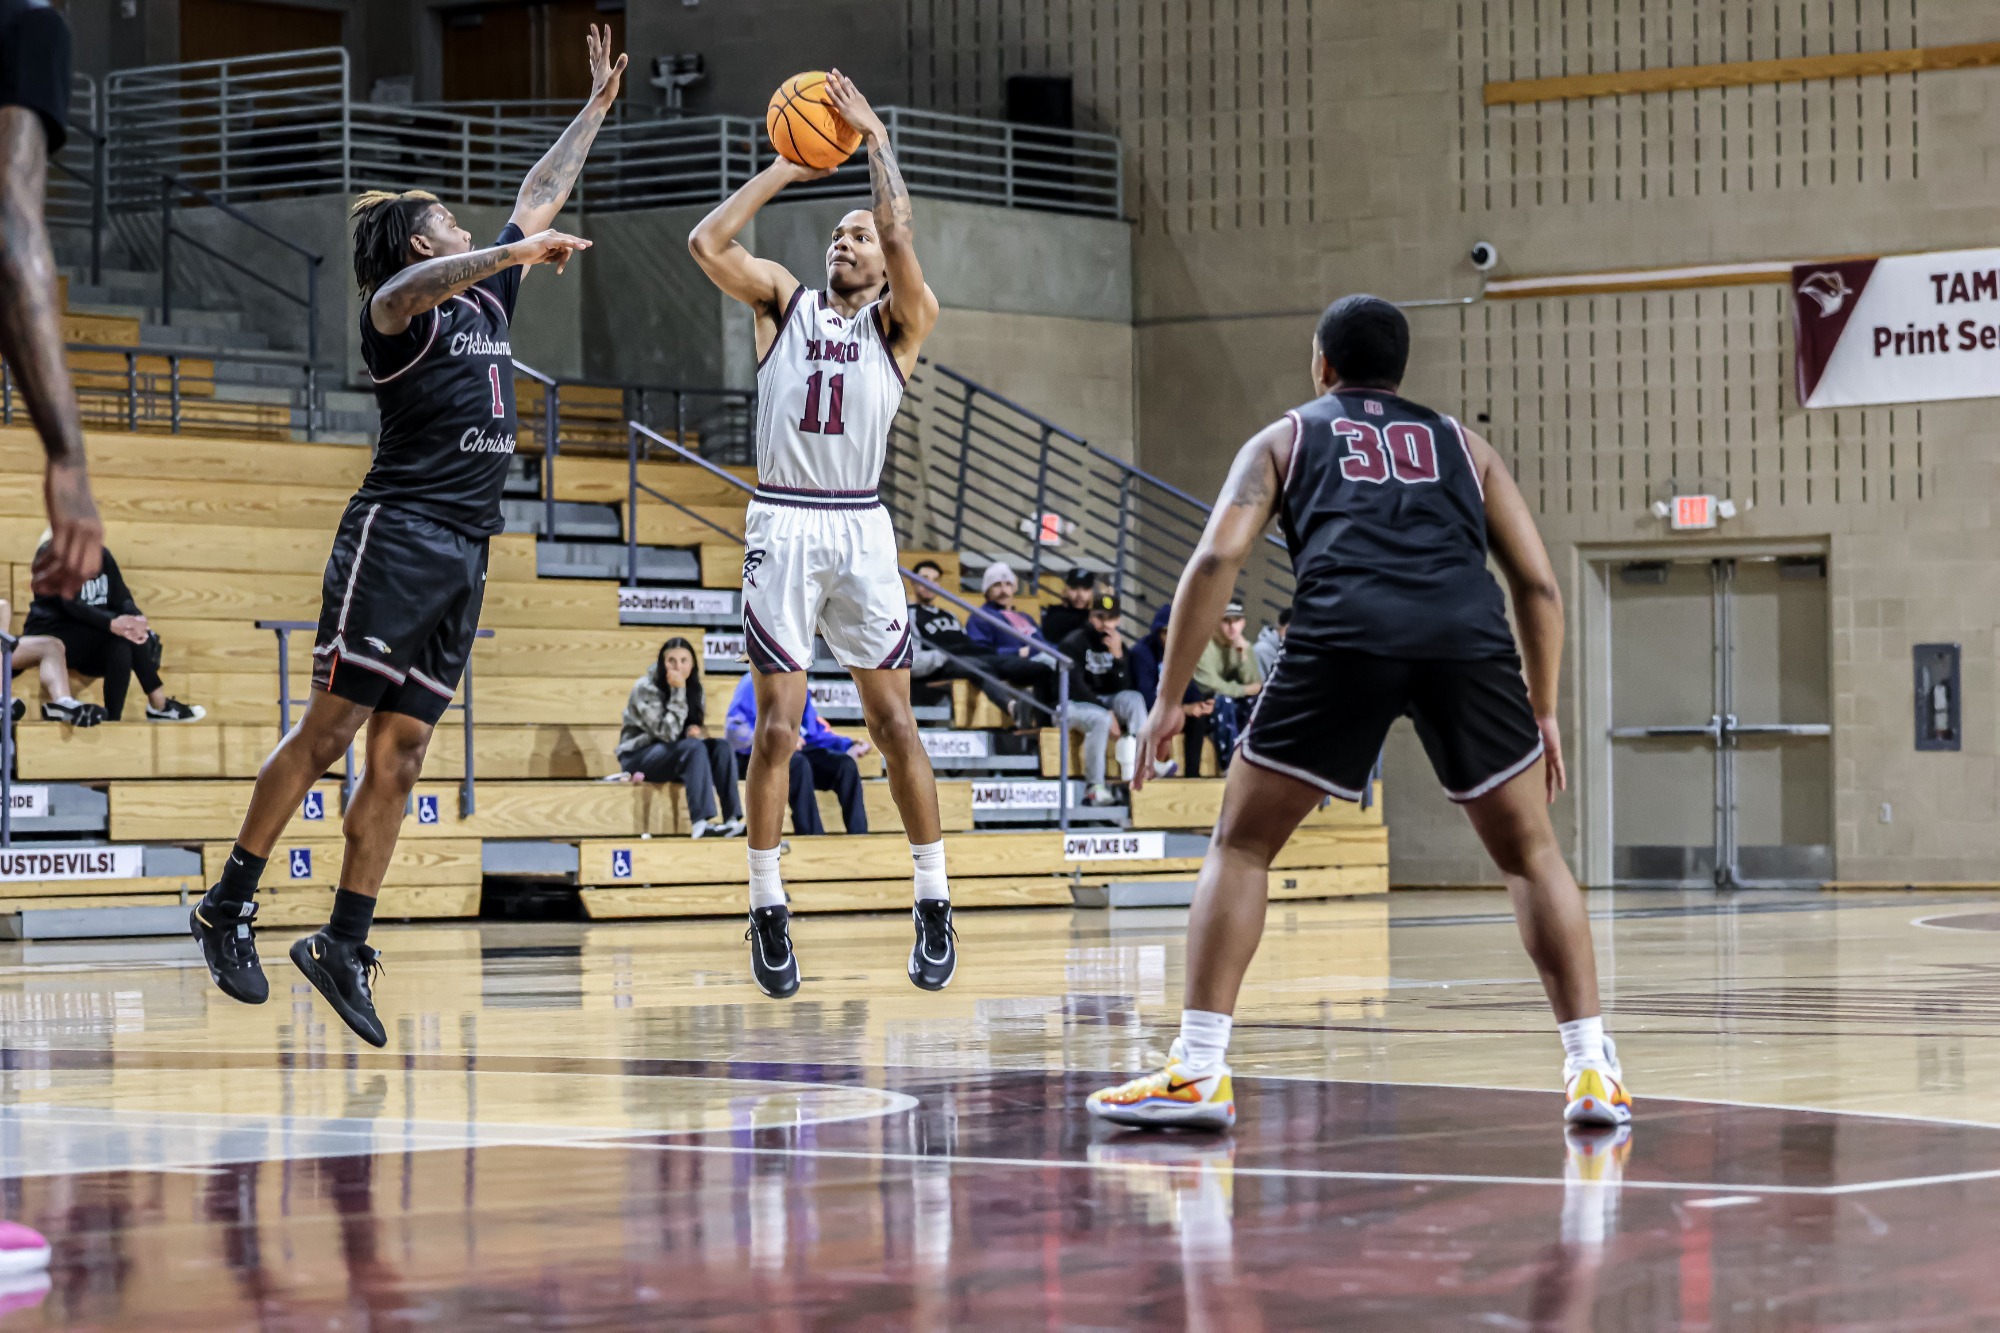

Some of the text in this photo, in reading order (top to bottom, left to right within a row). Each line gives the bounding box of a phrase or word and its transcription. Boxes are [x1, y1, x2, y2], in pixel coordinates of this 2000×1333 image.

[1930, 270, 2000, 304] TAM
[1874, 320, 2000, 356] Print Se
[488, 363, 504, 418] 1
[799, 370, 844, 435] 11
[1330, 417, 1440, 484] 30
[0, 853, 115, 875] USTDEVILS!
[1064, 838, 1139, 855] OW/LIKE US
